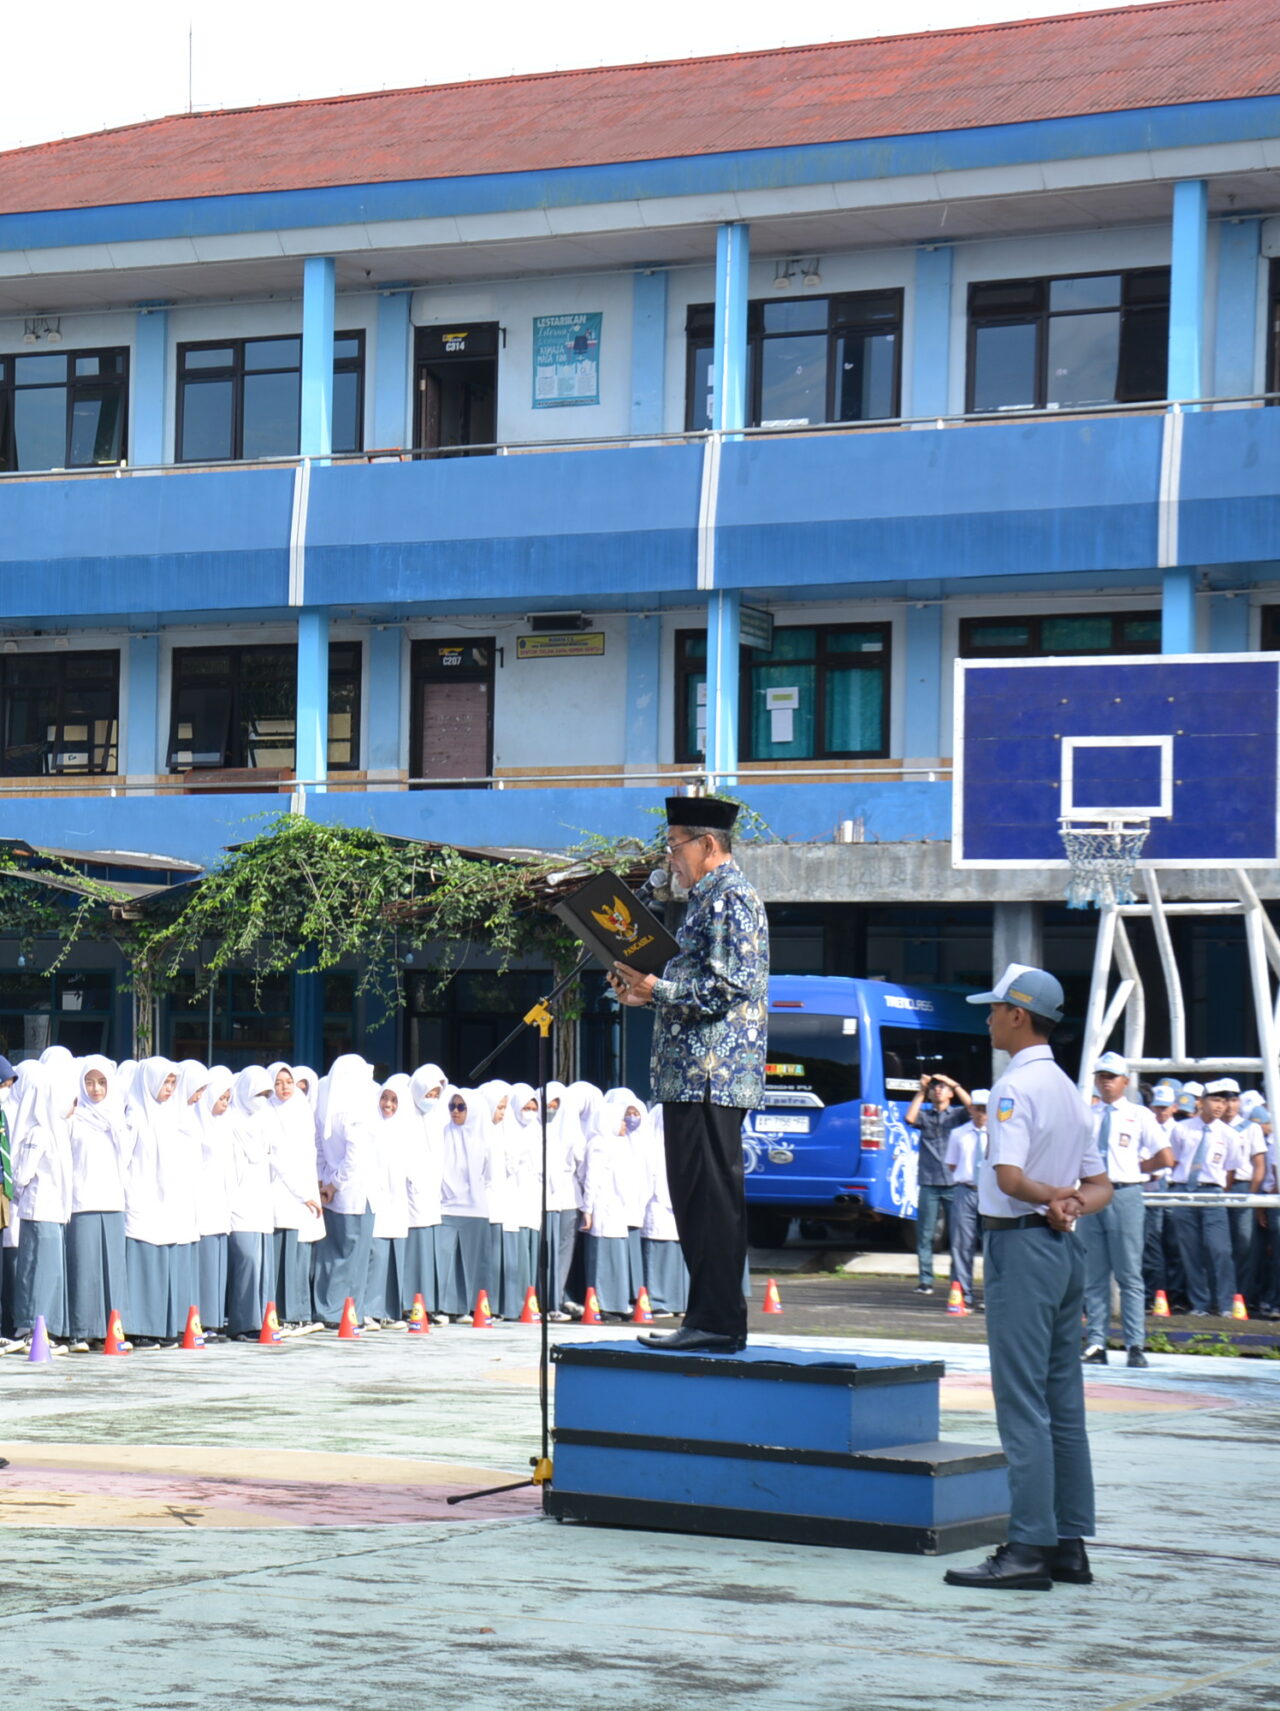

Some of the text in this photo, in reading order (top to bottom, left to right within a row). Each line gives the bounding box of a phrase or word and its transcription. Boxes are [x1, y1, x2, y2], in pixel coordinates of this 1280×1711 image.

[537, 315, 586, 327] LESTARIKAN
[446, 341, 465, 351] C314
[442, 656, 462, 666] C207
[623, 935, 655, 957] PANCASILA
